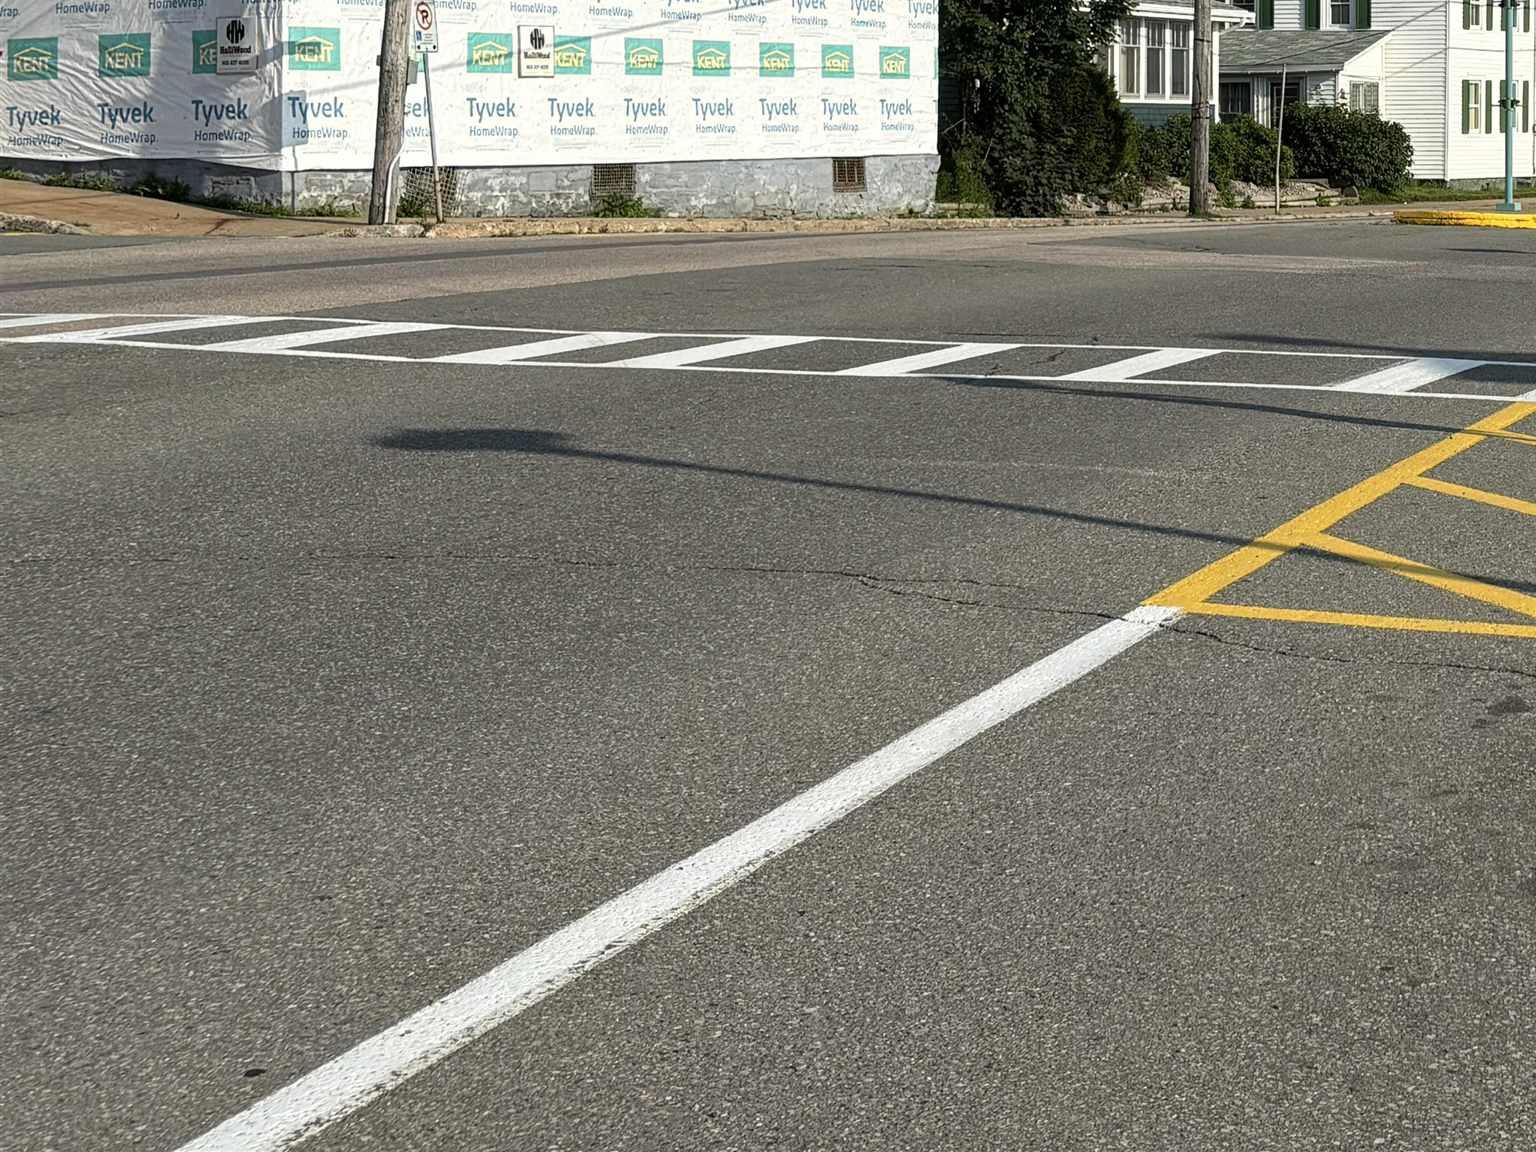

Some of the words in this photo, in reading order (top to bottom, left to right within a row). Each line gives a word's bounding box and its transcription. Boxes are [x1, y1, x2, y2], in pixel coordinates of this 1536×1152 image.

[56, 1, 110, 15] HomeWrap
[511, 2, 557, 15] HomeWrap
[589, 6, 632, 18] HomeWrap
[661, 9, 702, 21] HomeWrap
[728, 13, 767, 24] HomeWrap
[105, 50, 143, 69] KENT
[200, 48, 216, 64] KE
[295, 46, 334, 63] KENT
[555, 53, 585, 68] KENT
[631, 55, 657, 69] KENT
[697, 56, 725, 69] KENT
[884, 60, 905, 73] KENT
[97, 101, 154, 129] Tyvek
[192, 98, 247, 127] Tyvek
[288, 97, 344, 123] Tyvek
[467, 97, 516, 122] Tyvek
[548, 98, 594, 122] Tyvek
[624, 98, 666, 121] Tyvek
[693, 98, 733, 120] Tyvek
[760, 98, 796, 120] Tyvek
[823, 98, 856, 120] Tyvek
[880, 99, 911, 119] Tyvek
[7, 105, 61, 132] Tyvek
[292, 127, 348, 138] HomeWrap
[470, 126, 518, 138] HomeWrap
[551, 126, 595, 136] HomeWrap
[626, 125, 668, 135] HomeWrap
[696, 124, 736, 134] HomeWrap
[762, 124, 799, 134] HomeWrap
[9, 134, 63, 146] HomeWrap
[101, 132, 156, 144] HomeWrap
[195, 130, 250, 143] HomeWrap
